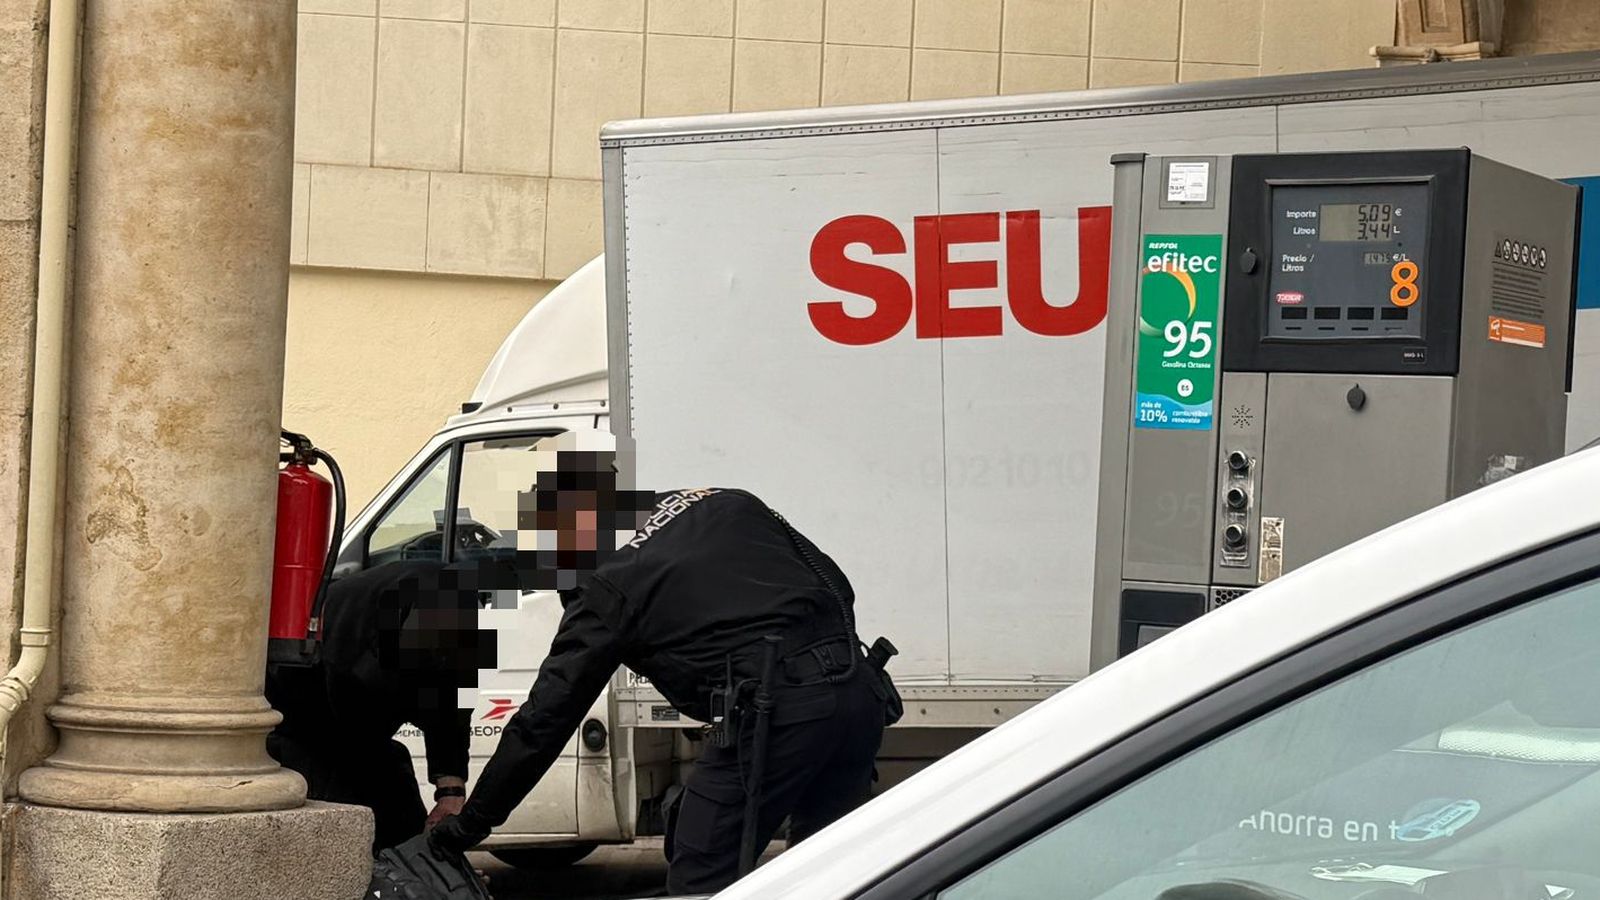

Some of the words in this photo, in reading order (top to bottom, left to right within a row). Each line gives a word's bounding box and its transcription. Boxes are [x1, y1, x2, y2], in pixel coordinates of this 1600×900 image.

[1286, 210, 1317, 219] Importe
[1293, 227, 1316, 235] Litros
[1393, 226, 1401, 234] L
[1147, 251, 1218, 273] efitec
[1282, 254, 1308, 263] Precio
[807, 206, 1113, 346] SEU
[1281, 264, 1305, 272] Litros
[1390, 260, 1420, 307] 8
[1163, 319, 1213, 359] 95
[1140, 409, 1168, 423] 10%
[1343, 820, 1378, 842] en
